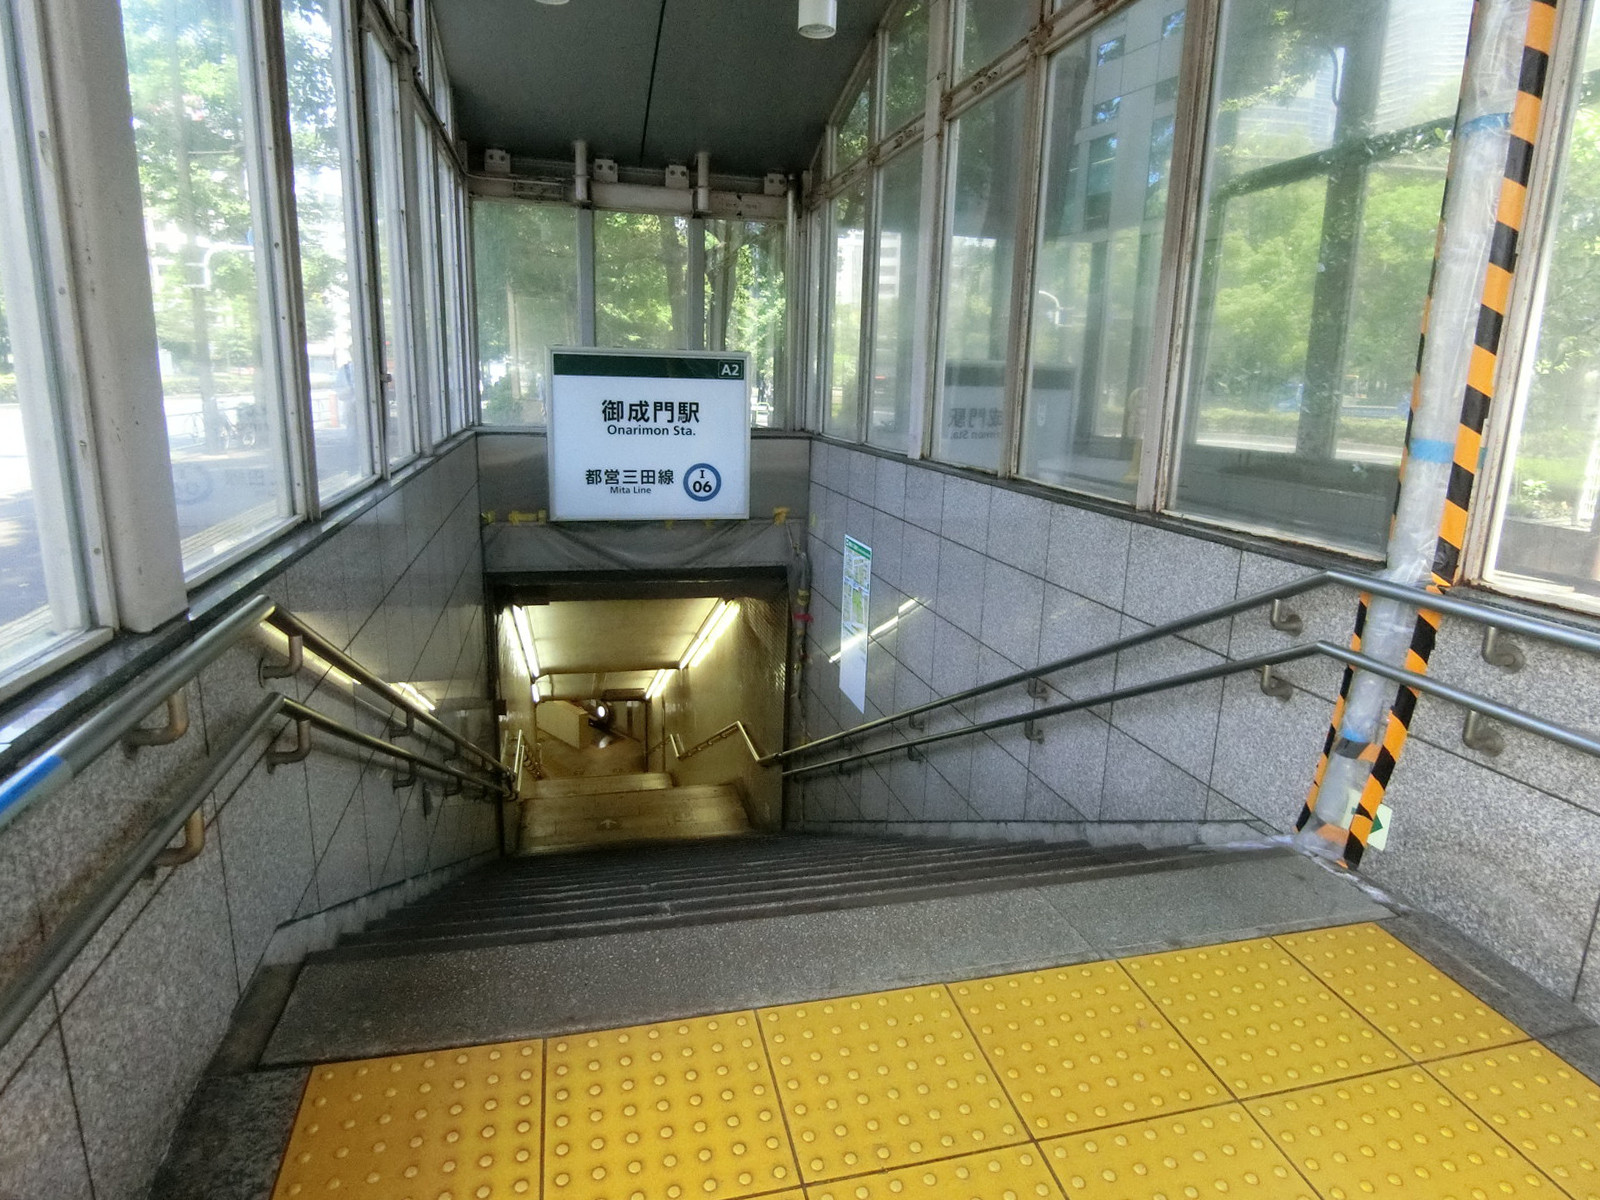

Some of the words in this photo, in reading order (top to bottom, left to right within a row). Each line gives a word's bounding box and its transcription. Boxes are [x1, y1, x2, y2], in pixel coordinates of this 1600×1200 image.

[721, 364, 740, 376] A2
[601, 399, 700, 423] 御成門駅
[607, 424, 669, 436] Onarimon
[673, 424, 696, 436] Sta.
[585, 468, 675, 486] 都営三田線
[610, 486, 631, 494] Mita
[633, 486, 652, 494] Line
[692, 481, 713, 493] 06
